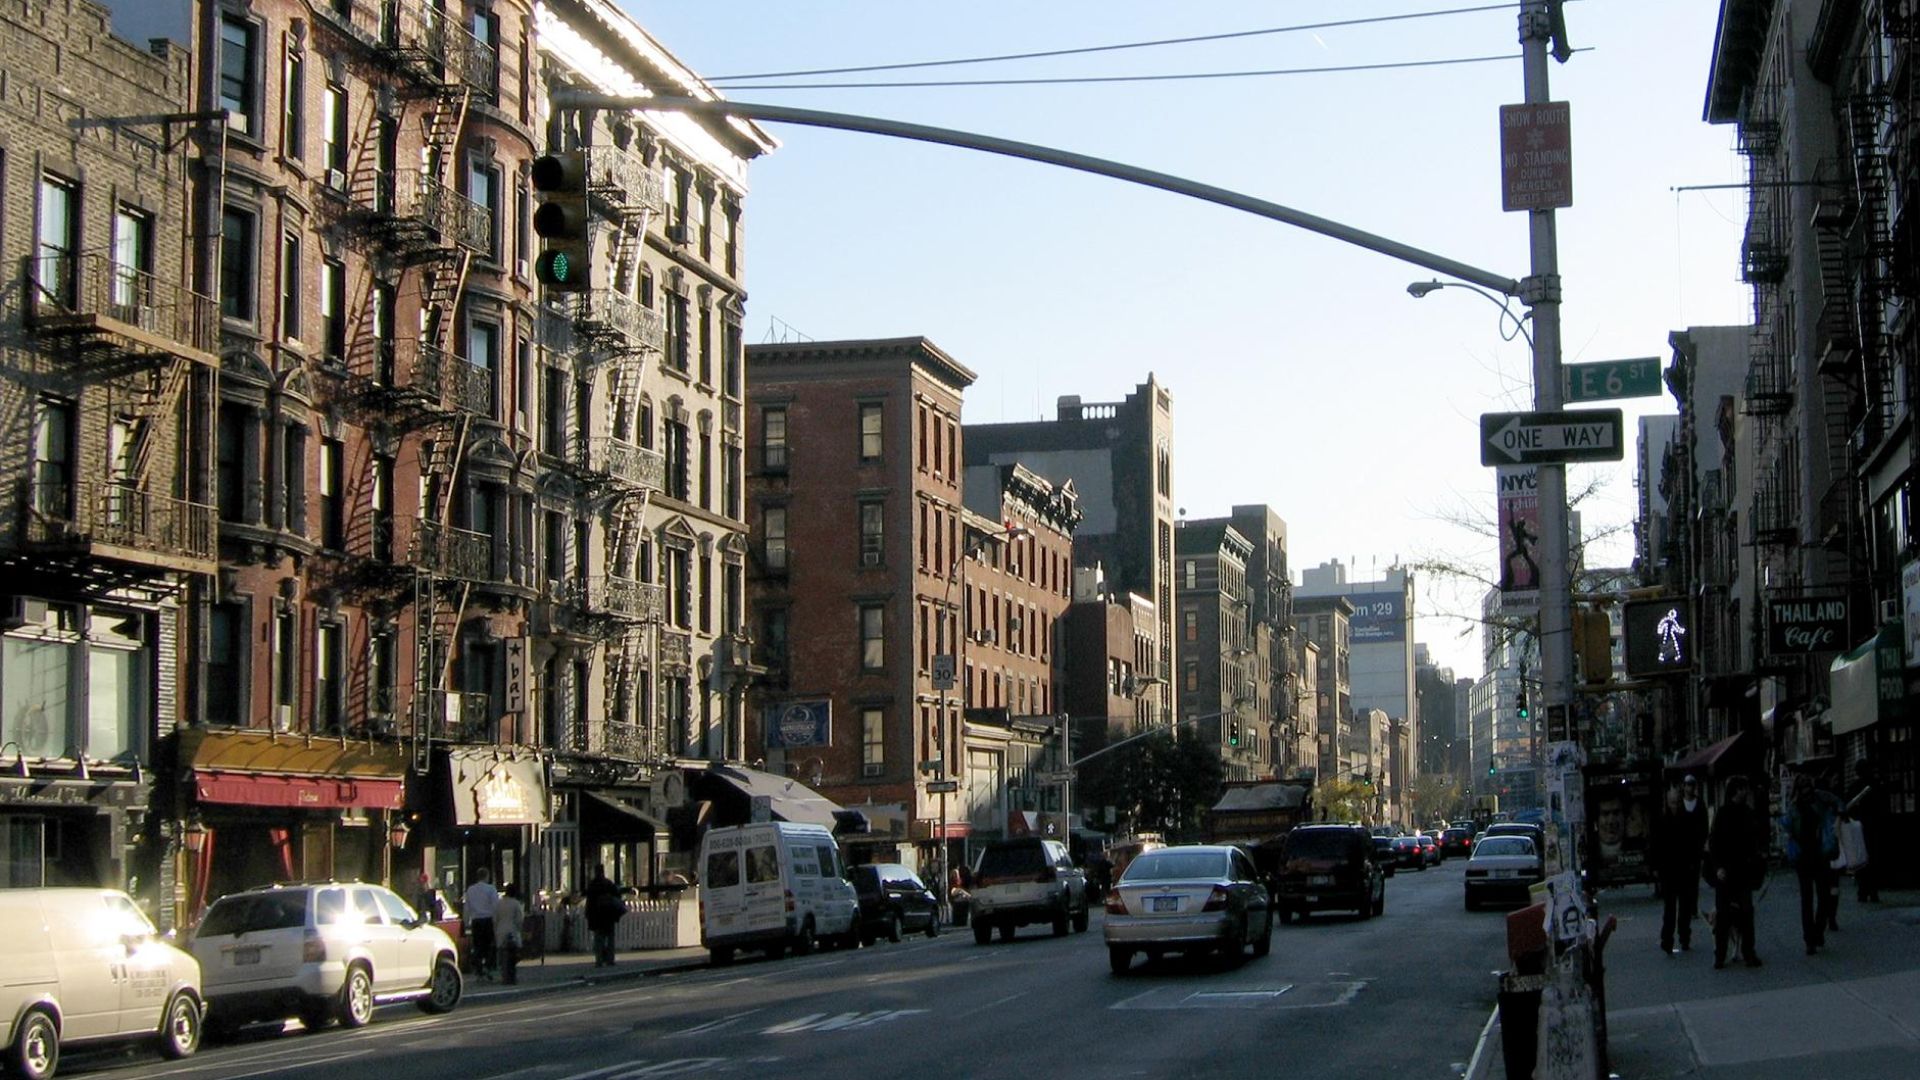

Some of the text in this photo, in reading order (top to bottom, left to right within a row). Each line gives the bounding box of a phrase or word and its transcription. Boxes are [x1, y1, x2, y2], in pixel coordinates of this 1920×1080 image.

[1504, 109, 1568, 128] SNOW ROUTE
[1505, 148, 1569, 168] NO STANDING
[1521, 167, 1553, 179] DURING
[1511, 179, 1562, 193] EMERGENCY
[1581, 362, 1647, 397] E 6 ST
[1503, 426, 1604, 450] ONE WAY
[1501, 474, 1538, 492] NYC
[1371, 601, 1393, 616] $29
[1772, 601, 1846, 624] THAILAND
[1784, 626, 1835, 652] Cafe
[1880, 647, 1901, 670] THAI
[509, 662, 521, 710] bar
[934, 669, 951, 682] 30
[1880, 677, 1904, 700] FOOD
